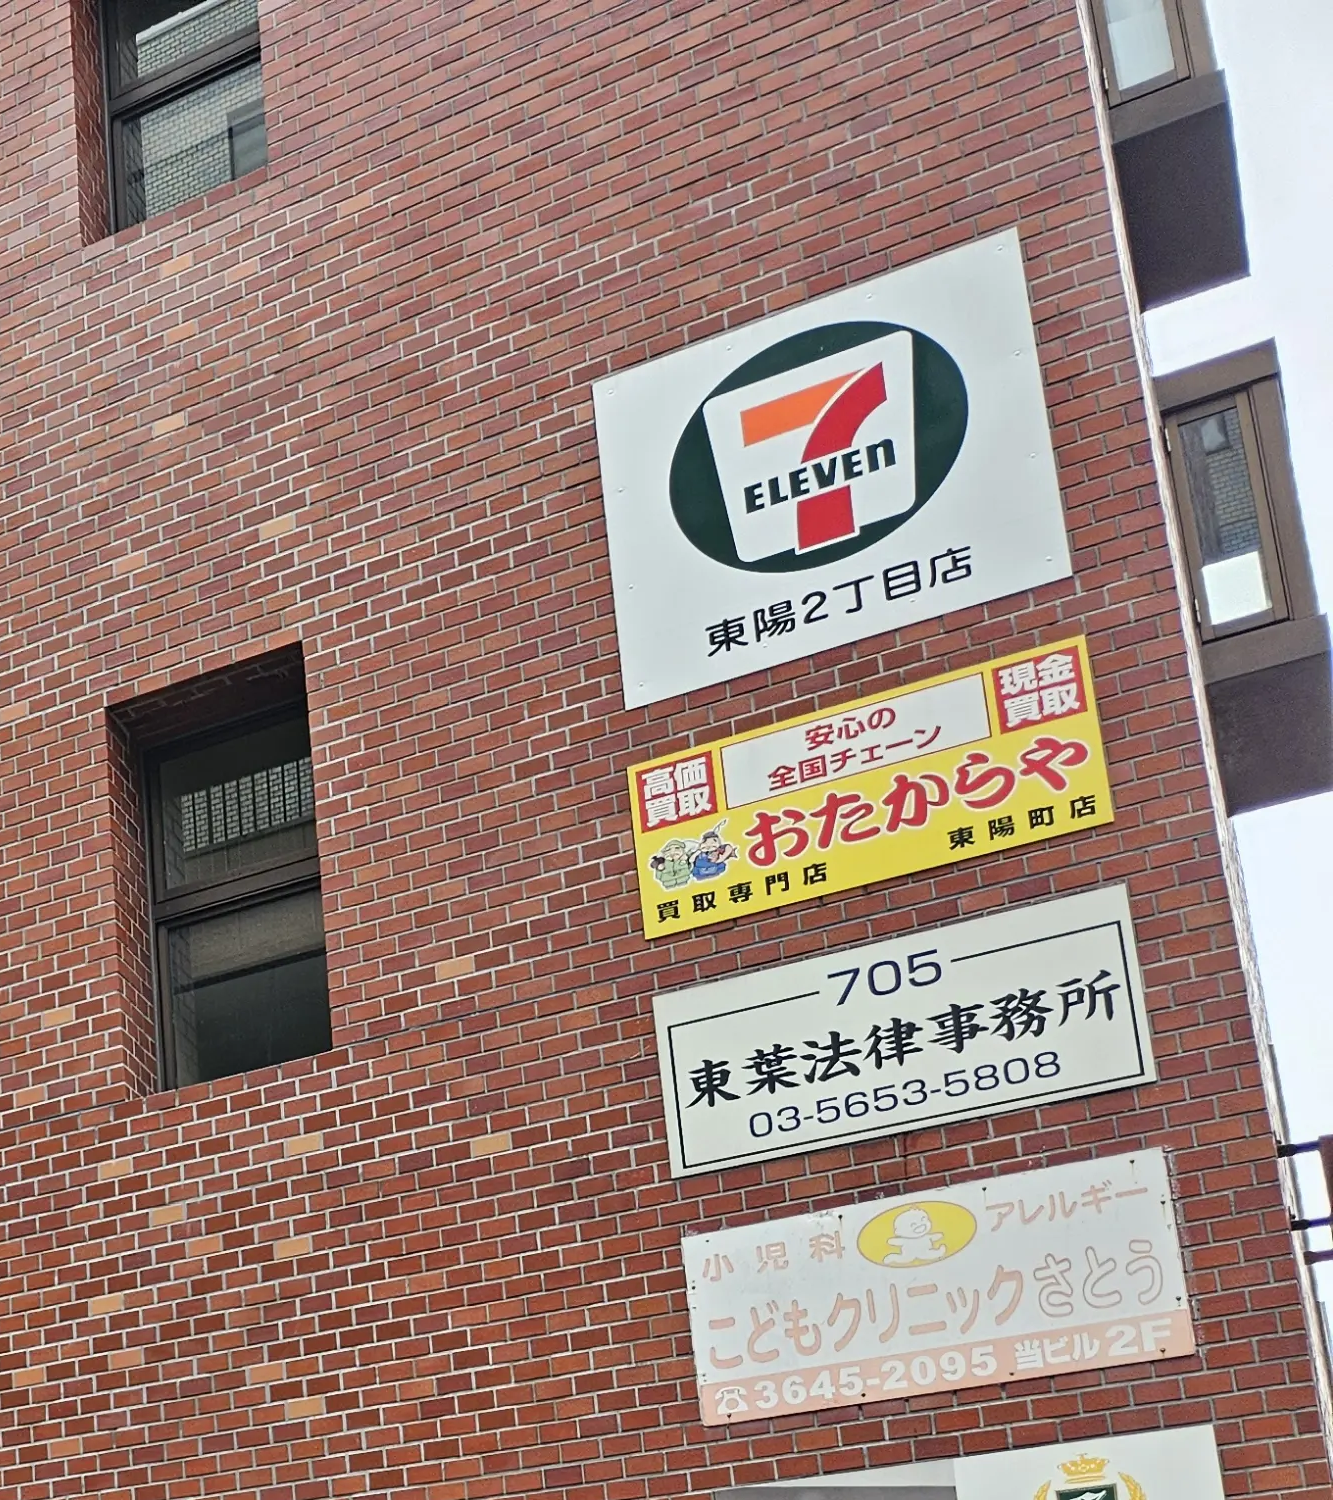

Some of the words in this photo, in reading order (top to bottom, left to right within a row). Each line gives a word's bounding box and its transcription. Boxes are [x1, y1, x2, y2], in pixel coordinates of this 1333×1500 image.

[704, 544, 974, 658] 東陽2丁目店
[998, 653, 1076, 693] 現金
[804, 706, 897, 751] 安心の
[1004, 683, 1082, 728] 買取
[641, 757, 708, 800] 高価
[767, 724, 942, 791] 全国チェーン
[644, 787, 712, 828] 買取
[744, 736, 1090, 868] おたからや
[947, 792, 1098, 851] 東陽町店
[656, 861, 829, 923] 買取専門店
[826, 949, 944, 1006] 705
[685, 968, 1122, 1110] 東葉法律事務所
[748, 1050, 1063, 1139] 03-5653-5808
[701, 1229, 846, 1282] 小児科
[985, 1184, 1149, 1232] アレルギー
[708, 1239, 1165, 1370] こどもクリニックさとう
[753, 1346, 999, 1411] 3645-2095
[1013, 1317, 1175, 1372] 当ビル2F
